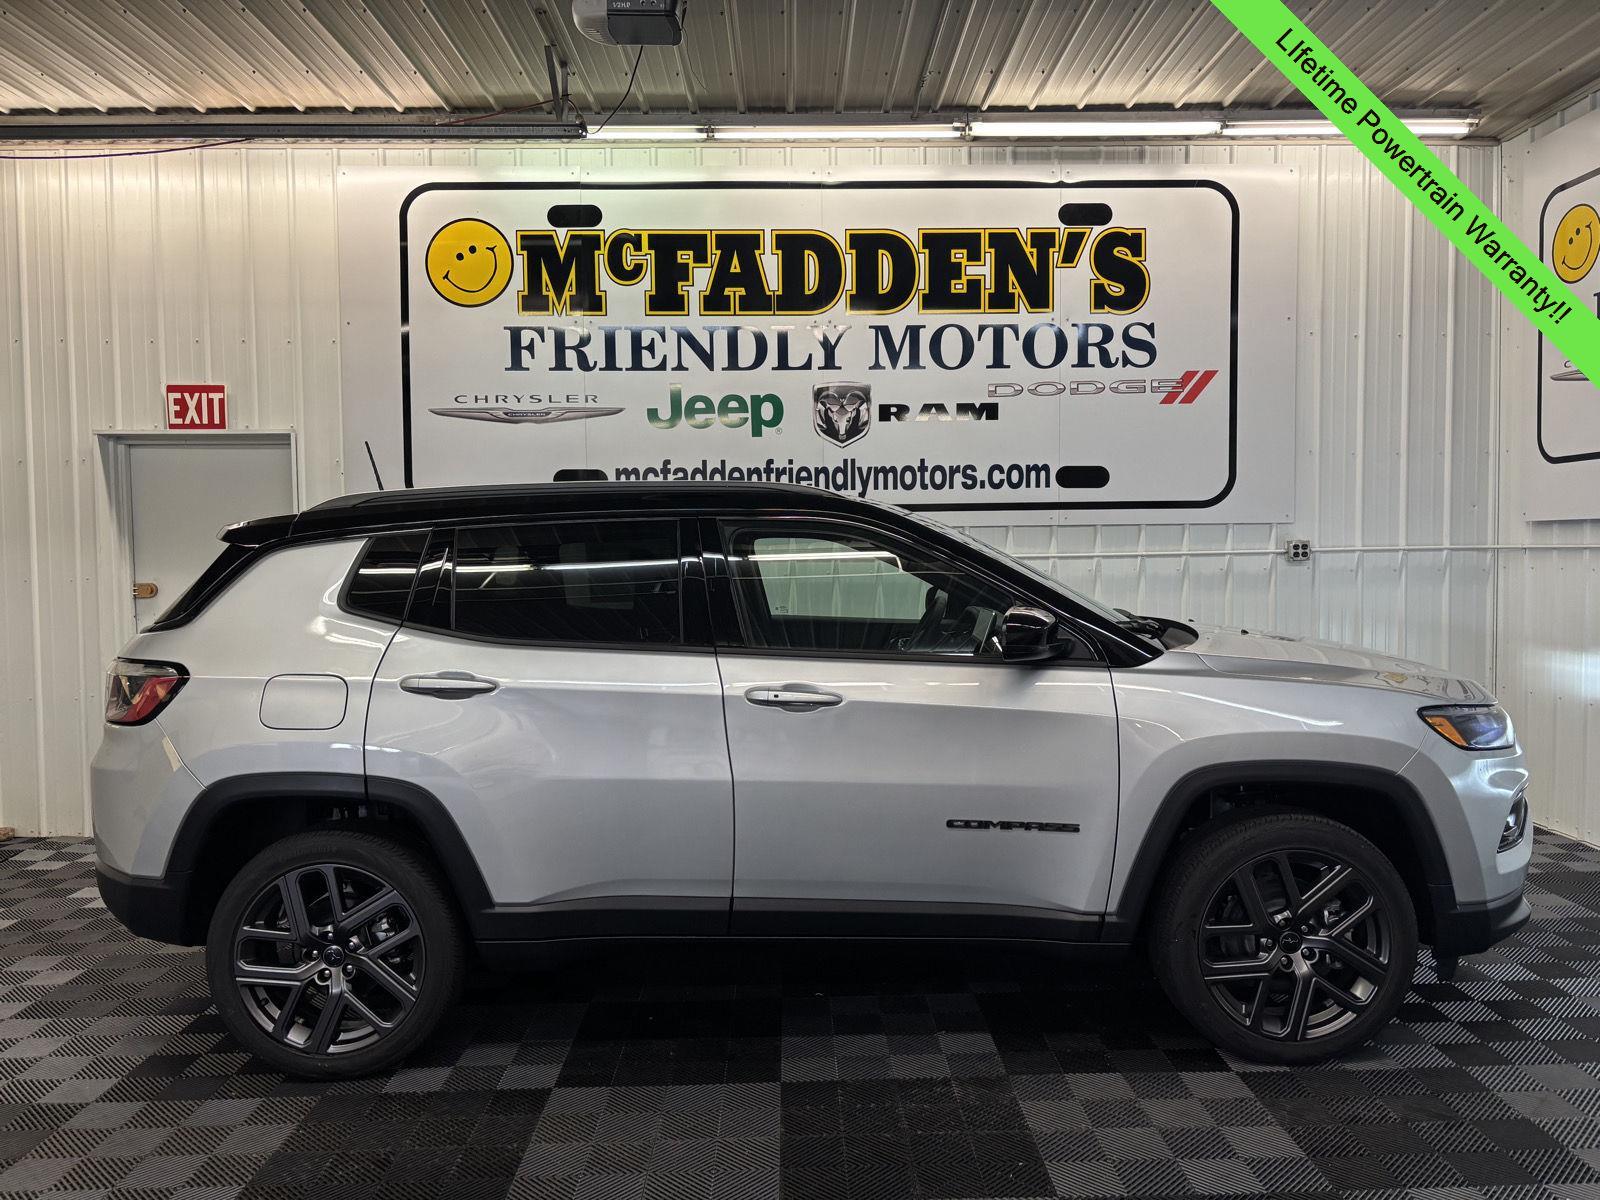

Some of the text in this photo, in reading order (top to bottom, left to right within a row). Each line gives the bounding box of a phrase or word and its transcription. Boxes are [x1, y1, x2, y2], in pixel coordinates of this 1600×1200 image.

[503, 322, 1157, 372] FRIENDLY MOTORS
[453, 394, 599, 405] CHRYSLER
[987, 378, 1185, 398] DODGE
[168, 392, 224, 425] EXIT
[646, 383, 784, 437] Jeep
[878, 402, 999, 422] RAM
[615, 457, 1050, 497] mcfaddenfriendlymotors.com
[946, 819, 1081, 833] COMPASS
